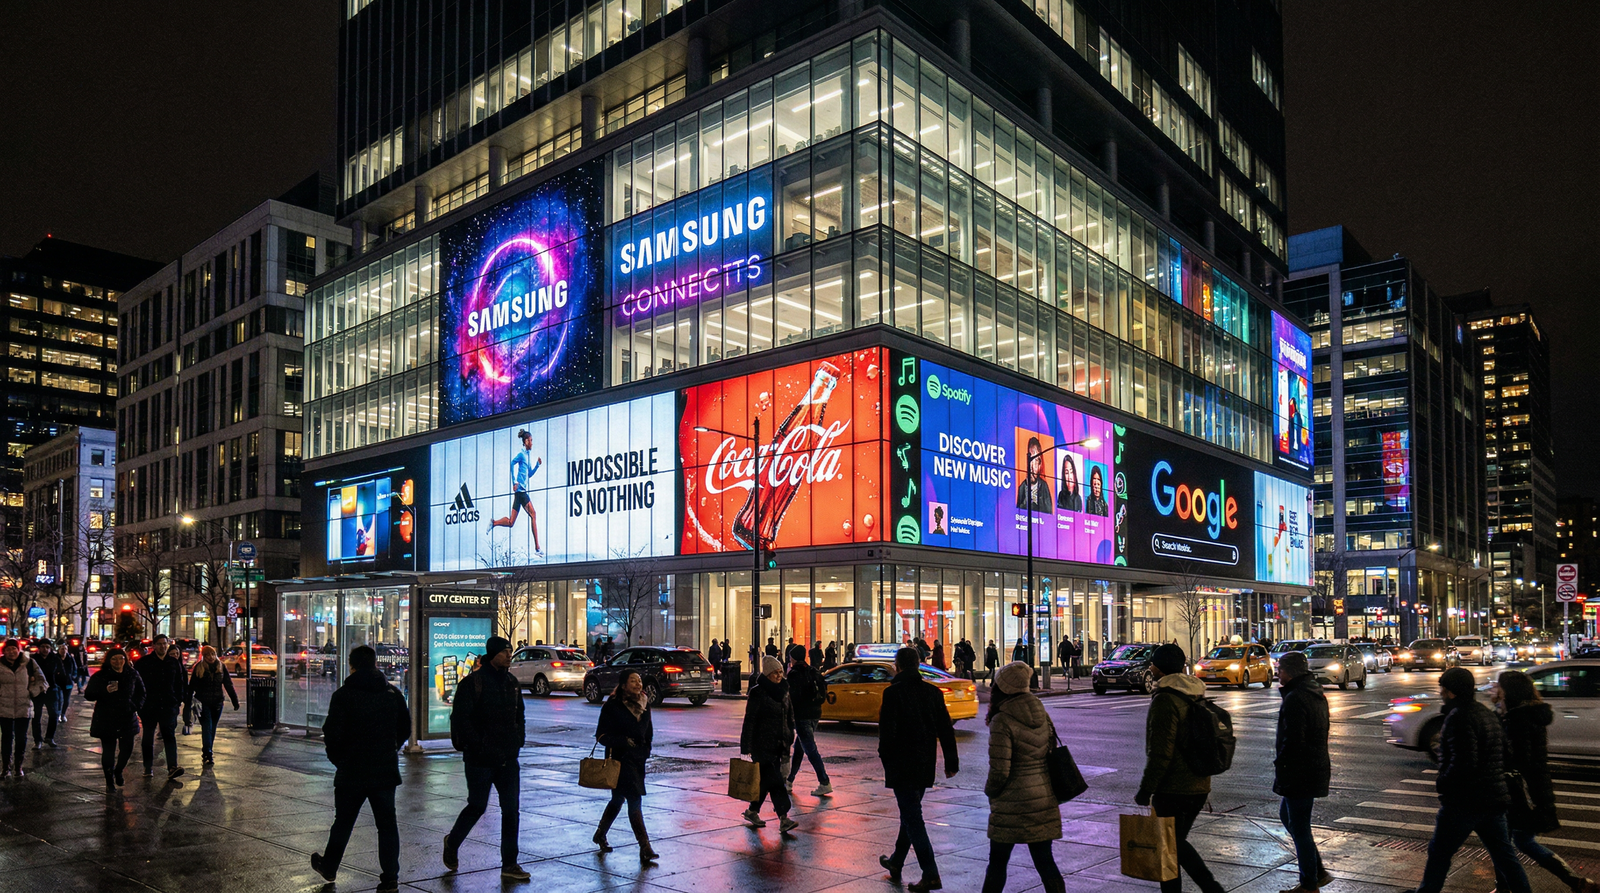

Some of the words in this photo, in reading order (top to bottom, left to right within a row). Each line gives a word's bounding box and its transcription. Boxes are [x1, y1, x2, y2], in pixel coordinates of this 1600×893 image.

[620, 195, 766, 274] SAMSUNG
[622, 254, 761, 317] CONNECTTS
[467, 279, 568, 337] SAMSUNG
[942, 383, 972, 406] Spotify
[567, 447, 658, 487] IMPOSSIBLE
[939, 432, 1006, 466] DISCOVER
[933, 455, 967, 481] NEW
[969, 463, 1012, 490] MUSIC
[445, 508, 480, 526] adidas
[569, 490, 583, 517] IS
[586, 480, 655, 516] NOTHING
[1151, 460, 1238, 540] Google
[429, 594, 448, 604] CITY
[449, 594, 479, 605] CENTER
[480, 596, 491, 605] ST
